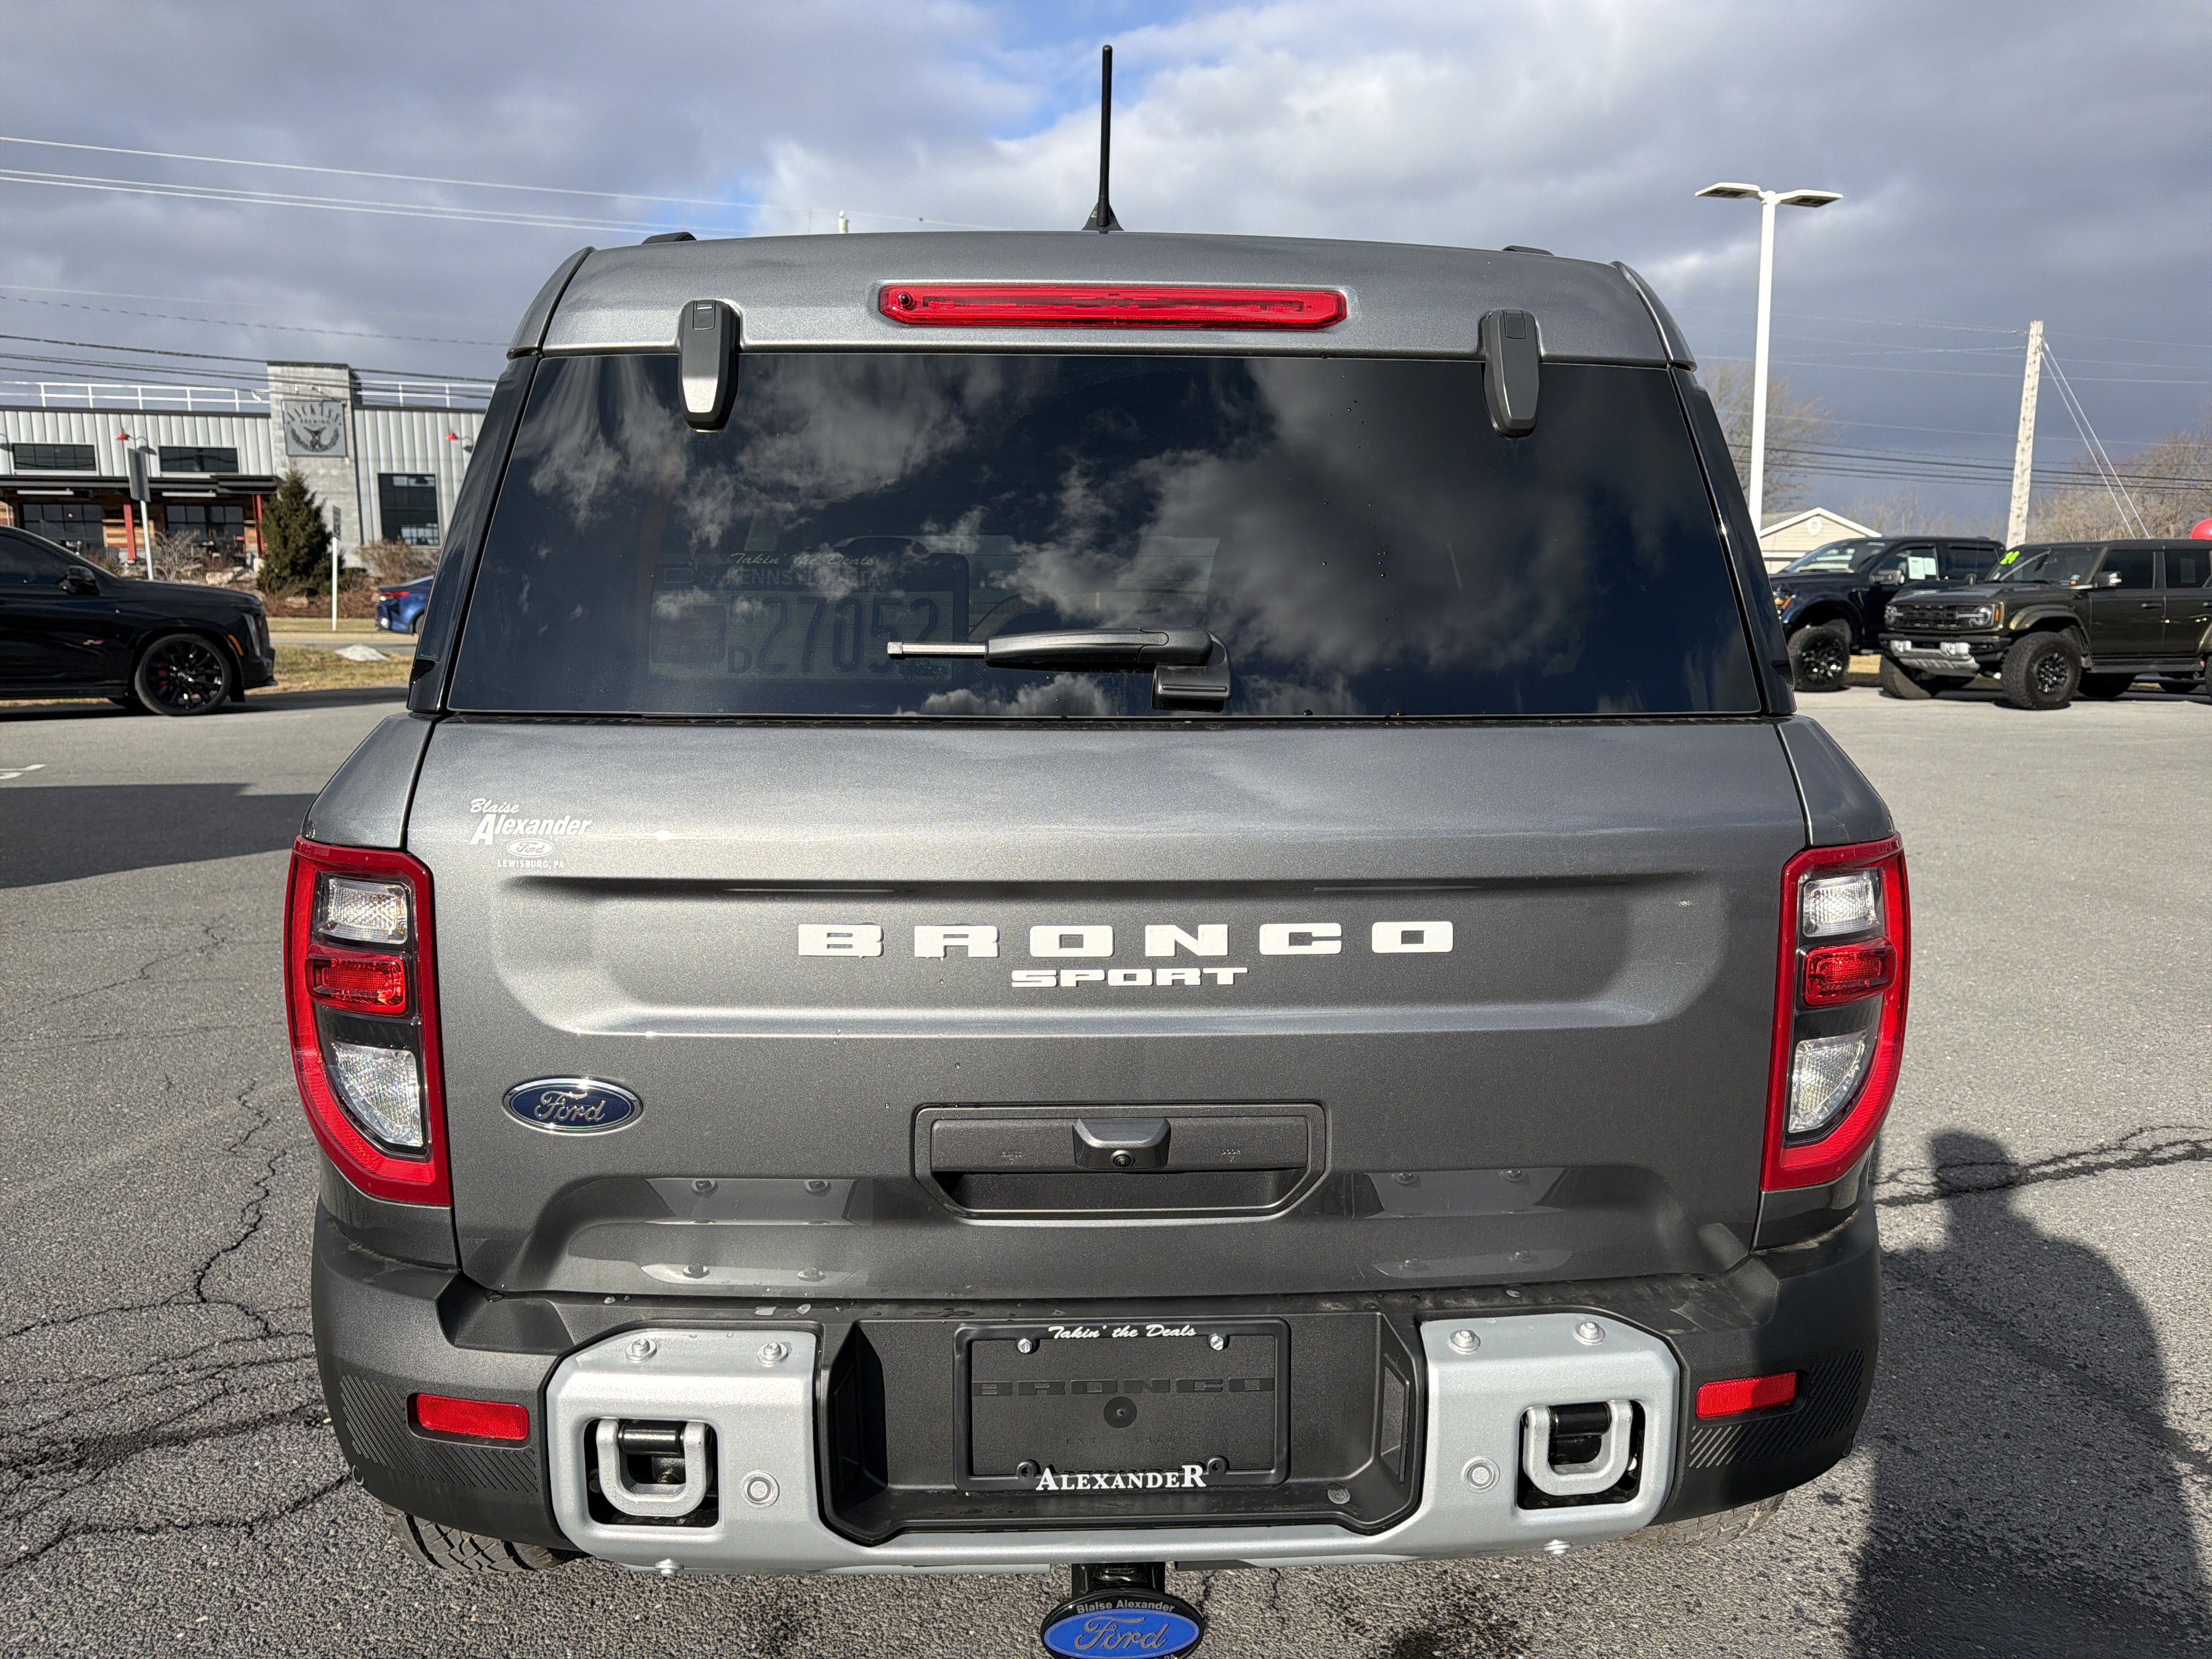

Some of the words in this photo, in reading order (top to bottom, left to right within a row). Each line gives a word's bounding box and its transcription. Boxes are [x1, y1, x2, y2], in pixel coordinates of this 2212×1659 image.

[731, 552, 787, 565] Takin'
[793, 553, 818, 565] the
[826, 552, 875, 566] Deals
[470, 798, 520, 814] Blaise
[469, 814, 592, 845] Alexander
[516, 842, 545, 854] Ford
[497, 859, 551, 870] LEWISBURG,
[553, 860, 565, 869] PA
[798, 921, 1454, 958] BRONCO
[1011, 967, 1248, 988] SPORT
[533, 1091, 606, 1122] Ford
[1048, 1325, 1107, 1340] Takin'
[1111, 1325, 1139, 1338] the
[1146, 1324, 1197, 1338] Deals
[972, 1378, 1274, 1396] BRONCO
[1036, 1464, 1206, 1491] ALEXANDER
[1076, 1601, 1113, 1614] Blaise
[1116, 1599, 1175, 1613] Alexander
[1074, 1616, 1171, 1650] Ford
